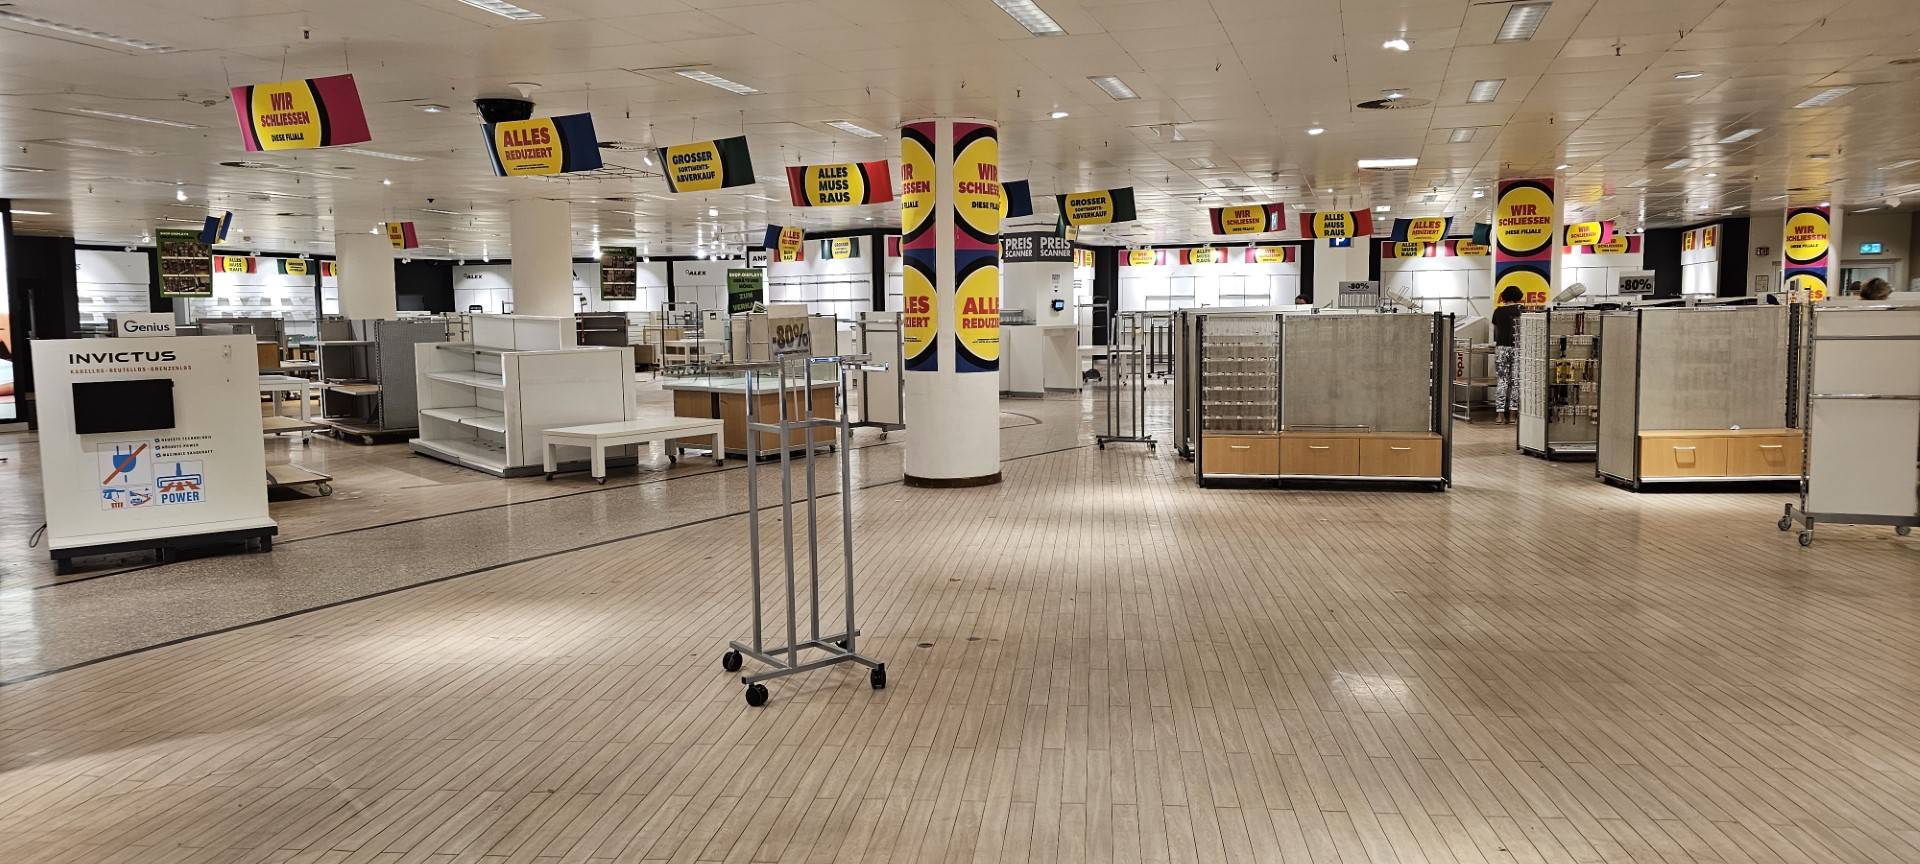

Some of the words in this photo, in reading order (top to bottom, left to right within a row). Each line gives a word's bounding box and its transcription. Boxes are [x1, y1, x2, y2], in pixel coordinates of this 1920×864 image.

[271, 92, 294, 111] WIR
[261, 111, 310, 127] SCHLIESSEN
[272, 134, 286, 142] DIESE
[286, 133, 305, 141] FILIALE
[504, 127, 550, 147] ALLES
[506, 147, 552, 160] REDUZIERT
[672, 151, 713, 164] GROSSER
[678, 164, 710, 172] SORTIMENTS-
[818, 167, 848, 179] ALLES
[902, 163, 913, 180] IR
[677, 171, 715, 183] ABVERKAUF
[818, 180, 849, 191] MUSS
[819, 192, 851, 203] RAUS
[1070, 197, 1106, 206] GROSSER
[971, 201, 989, 209] DIESE
[1510, 204, 1536, 216] WIR
[1072, 211, 1107, 219] ABVERKAUF
[1234, 210, 1250, 218] WIR
[1413, 220, 1441, 229] ALLES
[1498, 217, 1550, 226] SCHLIESSEN
[783, 230, 801, 239] ALLES
[1794, 225, 1814, 234] WIR
[1005, 237, 1033, 251] PREIS
[1039, 237, 1071, 250] PREIS
[1005, 249, 1033, 258] SCANNER
[1039, 249, 1071, 257] SCANNER
[1620, 279, 1651, 290] -80%
[124, 320, 170, 332] Genius
[772, 323, 808, 349] -80%
[69, 350, 177, 364] INVICTUS
[162, 491, 199, 503] POWER
